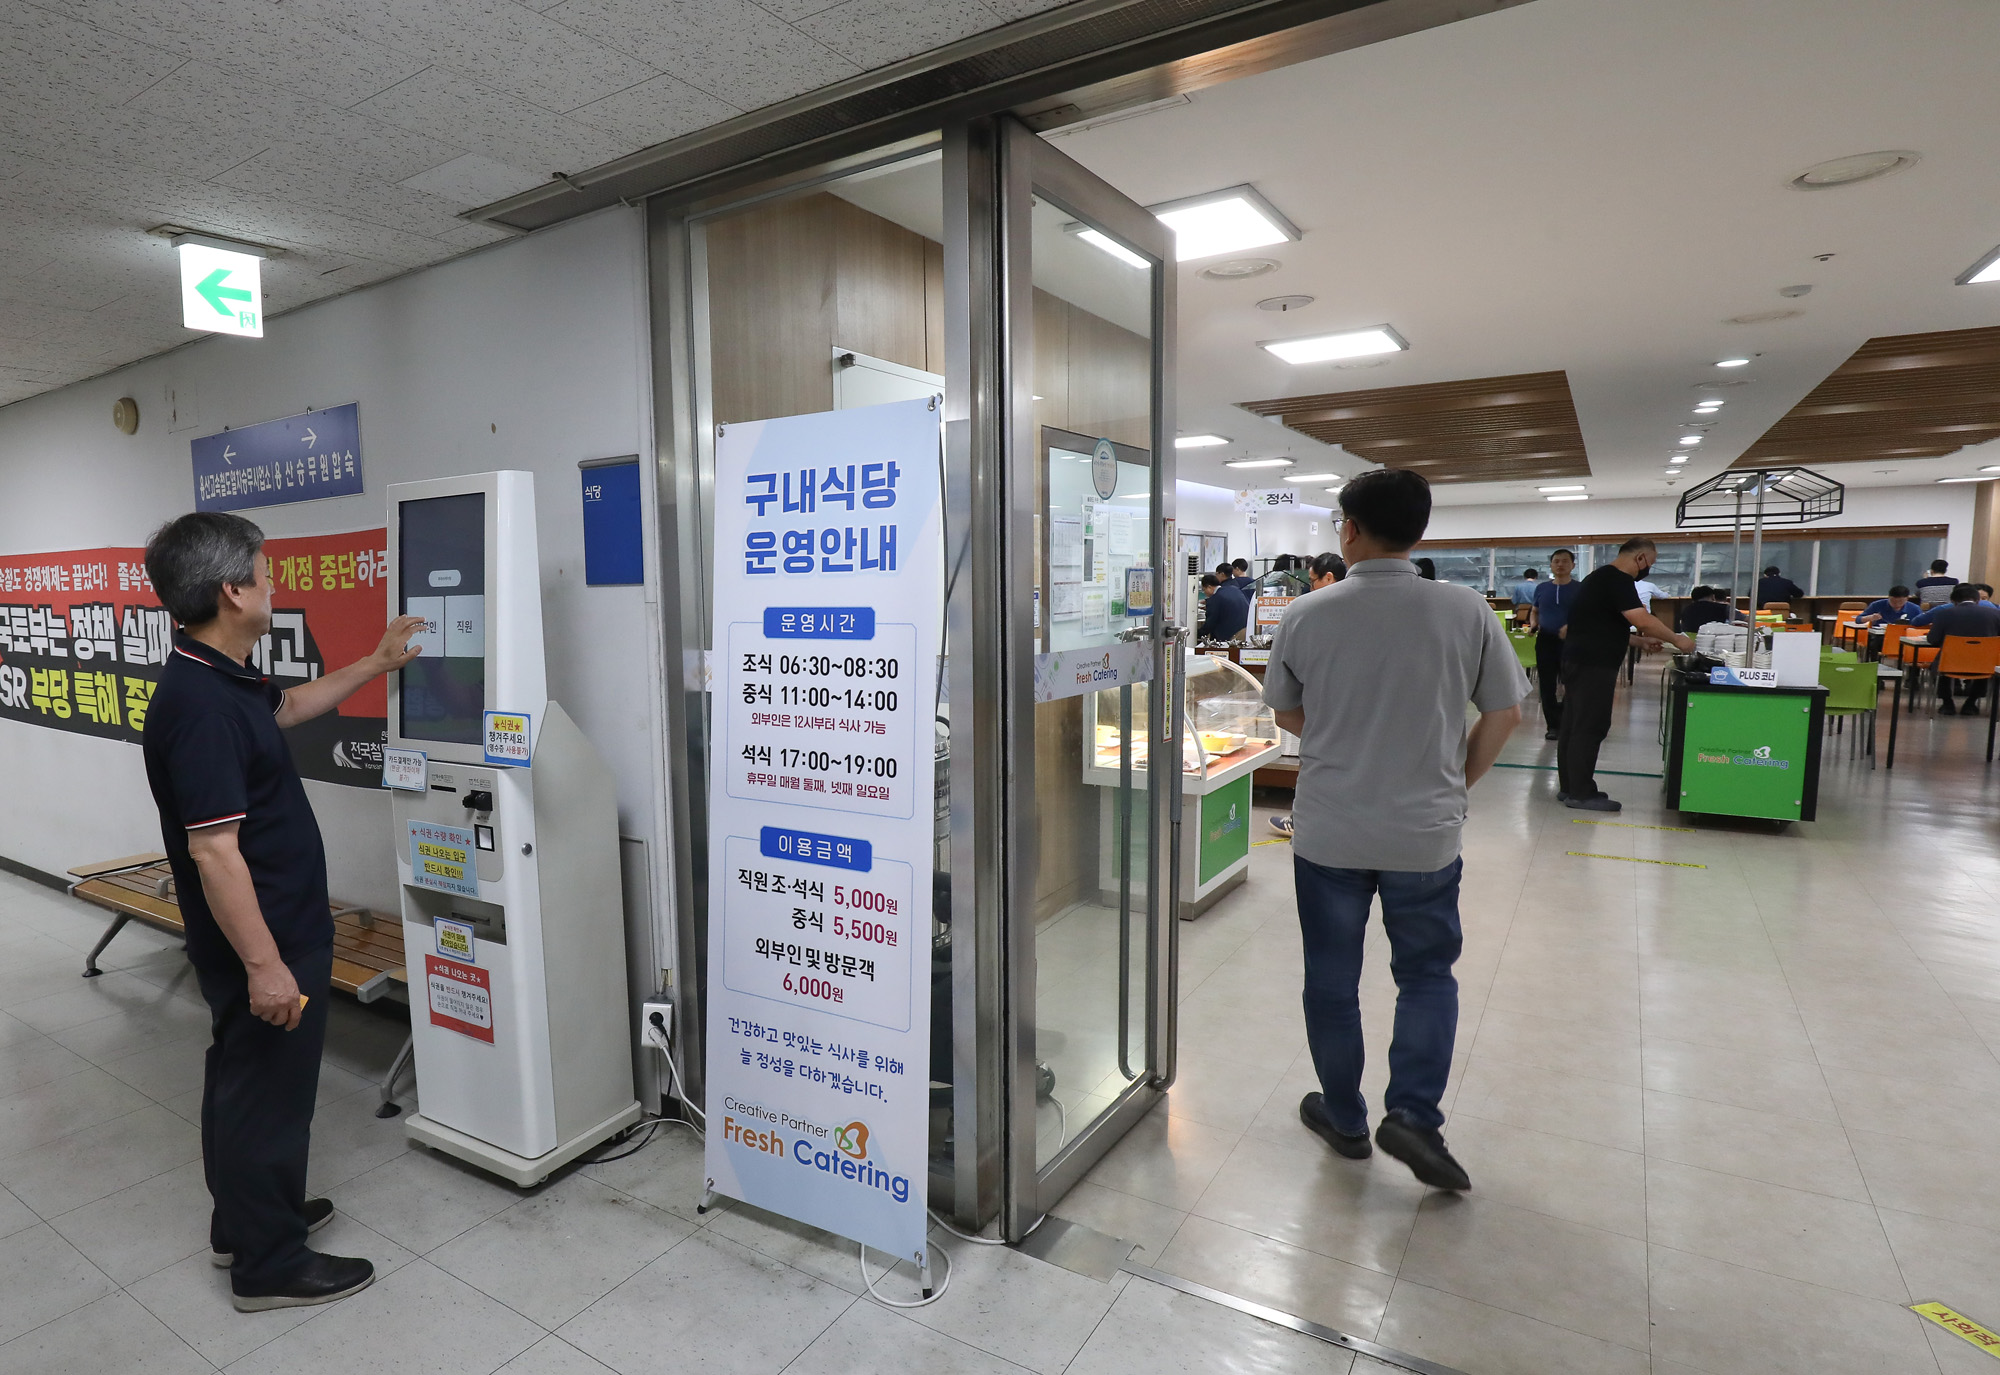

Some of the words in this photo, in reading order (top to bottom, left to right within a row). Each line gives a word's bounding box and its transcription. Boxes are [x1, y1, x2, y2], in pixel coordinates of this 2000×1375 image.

[585, 485, 601, 499] 식당
[745, 460, 901, 517] 구내식당
[1266, 493, 1294, 505] 정식
[745, 525, 897, 574] 운영안내
[24, 565, 70, 592] 경쟁체제는
[72, 562, 108, 591] 끝났다!
[280, 555, 314, 591] 개정
[70, 605, 117, 661] 정책
[456, 620, 473, 634] 직원
[781, 613, 856, 633] 운영시간
[743, 654, 772, 674] 조식
[780, 655, 899, 679] 06:30~08:30
[1076, 671, 1092, 684] Fresh
[1093, 667, 1118, 681] Catering
[1739, 671, 1760, 681] PLUS
[1761, 672, 1775, 681] 코너
[0, 664, 30, 710] SR
[30, 667, 72, 719] 부당
[74, 670, 121, 726] 특혜
[743, 683, 772, 705] 중식
[781, 685, 898, 711] 11:00~14:00
[489, 731, 526, 744] 챙겨주세요!
[500, 719, 514, 731] 식권
[751, 712, 791, 728] 외부인은
[794, 715, 835, 730] 12시부터
[838, 719, 861, 732] 식사
[864, 720, 886, 735] 가능
[412, 757, 423, 767] 가능
[741, 744, 771, 766] 석식
[780, 748, 897, 778] 17:00~19:00
[1698, 753, 1730, 764] Fresh
[1733, 755, 1789, 770] Catering
[747, 772, 777, 787] 휴무일
[779, 775, 800, 790] 매월
[803, 778, 827, 793] 둘째,
[831, 781, 852, 796] 넷째
[856, 783, 890, 800] 일요일
[420, 827, 432, 839] 식권
[434, 830, 447, 842] 수량
[449, 832, 462, 845] 확인
[778, 835, 852, 863] 이용금액
[419, 845, 431, 857] 식권
[433, 848, 451, 860] 나오는
[453, 851, 466, 864] 입구
[425, 862, 442, 875] 반드시
[738, 868, 768, 892] 직원
[834, 885, 898, 915] 5,000원
[791, 907, 823, 933] 중식
[833, 916, 898, 947] 5,500원
[438, 965, 449, 975] 식권
[451, 968, 467, 981] 나오는
[755, 937, 801, 966] 외부인
[805, 948, 821, 970] 및
[824, 951, 875, 982] 방문객
[782, 972, 844, 1003] 6,000원
[728, 1017, 778, 1043] 건강하고
[783, 1031, 823, 1056] 맛있는
[828, 1043, 870, 1069] 식사를
[875, 1055, 904, 1075] 위해
[740, 1047, 752, 1065] 늘
[757, 1052, 795, 1077] 정성을
[800, 1064, 888, 1103] 다하겠습니다.
[724, 1096, 778, 1123] Creative
[781, 1113, 829, 1138] Partner
[724, 1116, 784, 1157] Fresh
[793, 1139, 909, 1203] Catering
